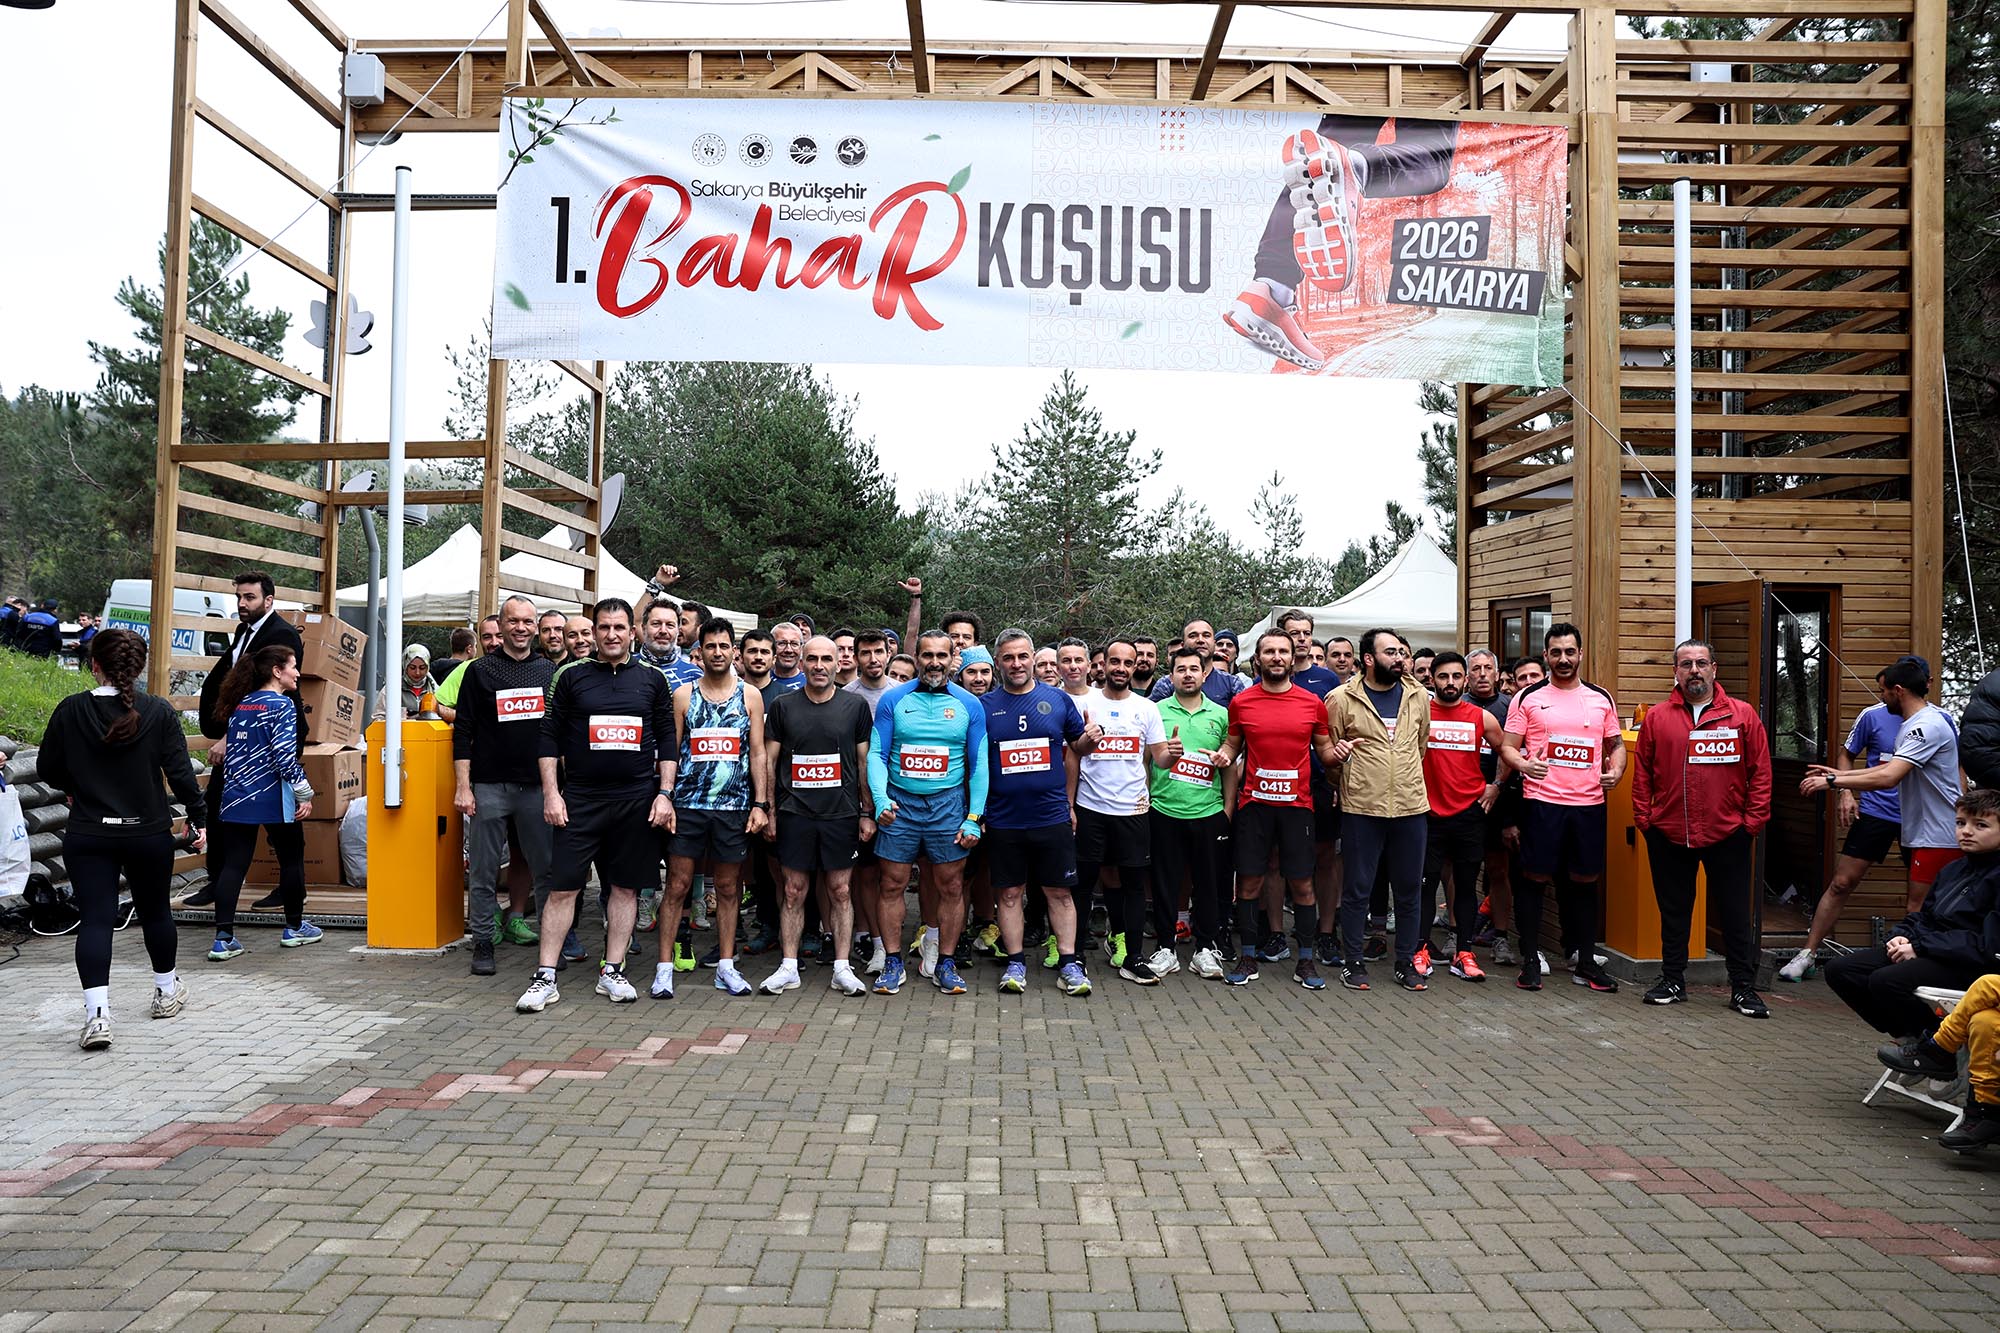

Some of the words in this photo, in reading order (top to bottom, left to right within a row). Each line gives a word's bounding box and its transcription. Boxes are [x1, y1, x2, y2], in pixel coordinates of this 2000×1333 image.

[691, 179, 763, 201] Sakarya
[769, 181, 867, 203] Büyükşehir
[779, 204, 866, 225] Belediyesi
[1400, 221, 1479, 260] 2026
[550, 196, 587, 284] 1.
[978, 202, 1212, 306] KOŞUSU
[1397, 264, 1530, 311] SAKARYA
[504, 699, 538, 712] 0467
[1018, 715, 1028, 732] 5
[596, 728, 637, 741] 0508
[1435, 730, 1469, 742] 0534
[698, 740, 733, 752] 0510
[1098, 740, 1134, 751] 0482
[1695, 742, 1735, 754] 0404
[1009, 751, 1042, 764] 0512
[1555, 746, 1588, 760] 0478
[905, 757, 942, 770] 0506
[1177, 762, 1210, 778] 0550
[798, 766, 834, 779] 0432
[1260, 780, 1291, 793] 0413
